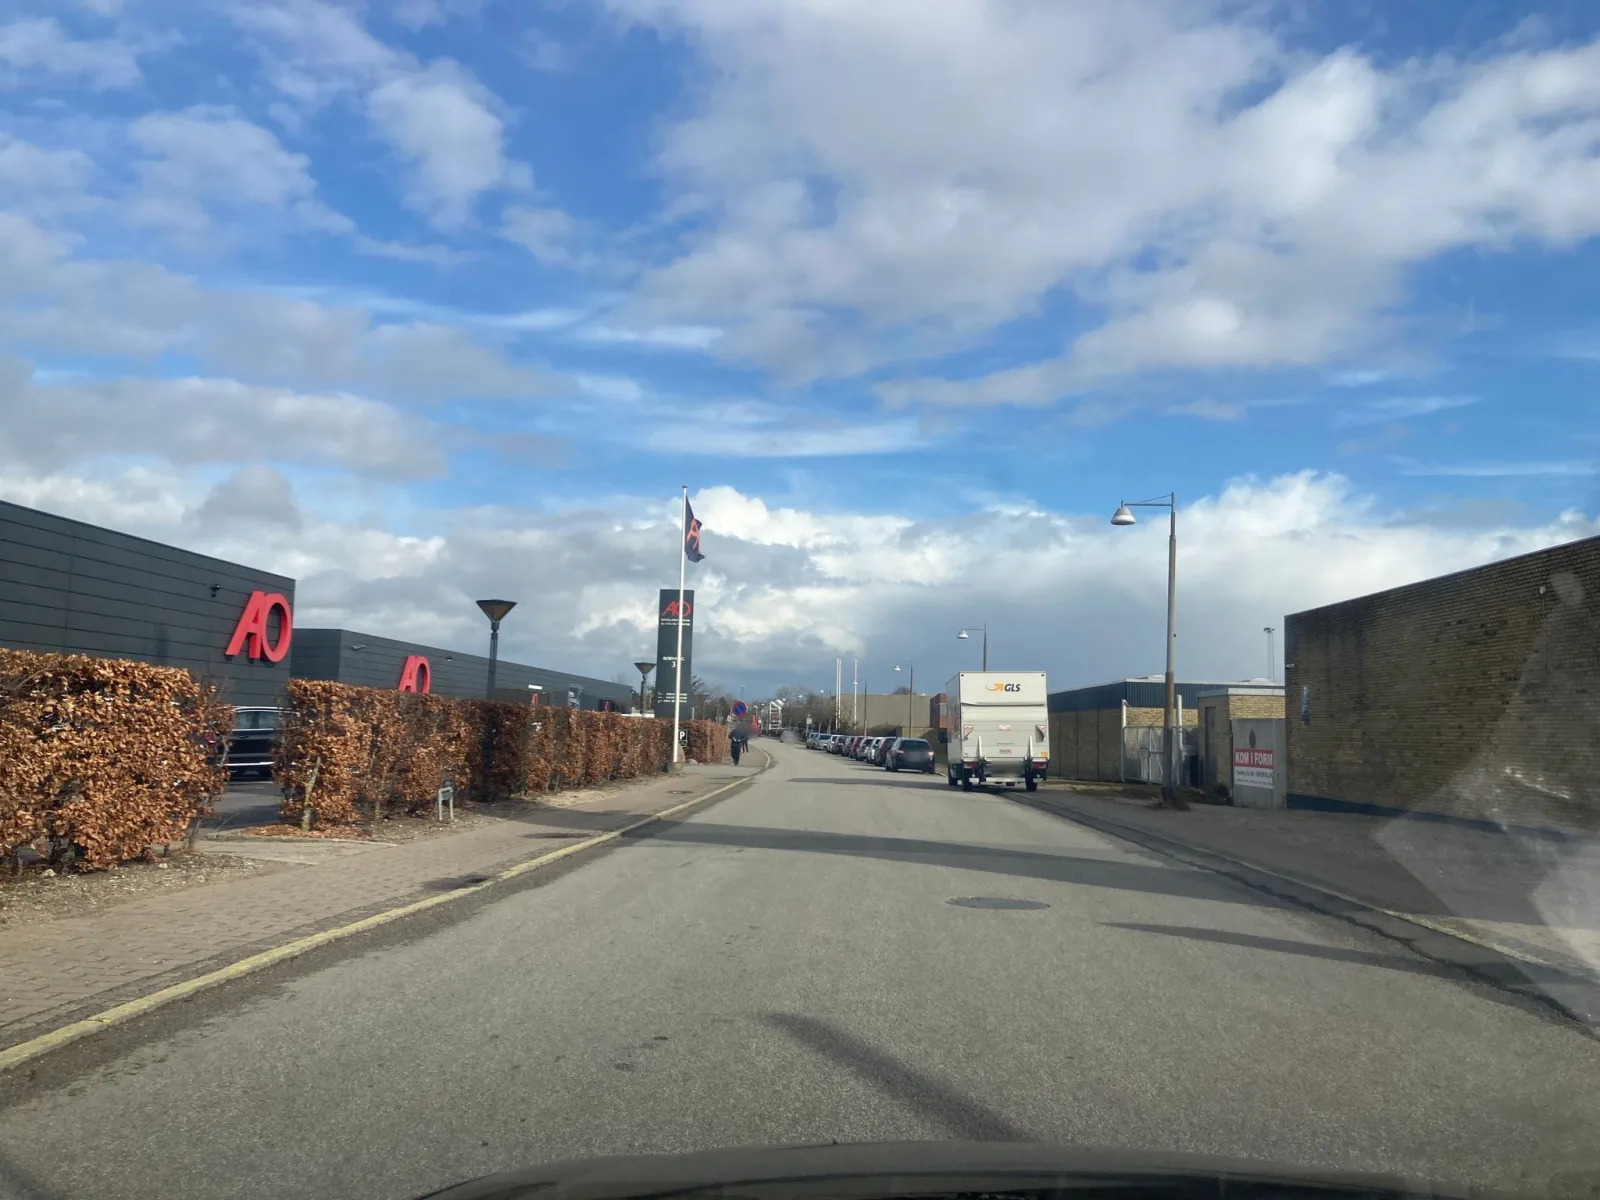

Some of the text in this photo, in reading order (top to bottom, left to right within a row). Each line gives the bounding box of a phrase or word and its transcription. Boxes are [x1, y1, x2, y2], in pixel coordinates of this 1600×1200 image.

[661, 600, 692, 617] AO
[225, 590, 292, 663] AO
[397, 655, 430, 693] AO
[1004, 683, 1021, 692] GLS
[680, 731, 686, 740] P
[1235, 751, 1249, 765] KOM
[1254, 752, 1273, 766] FORM
